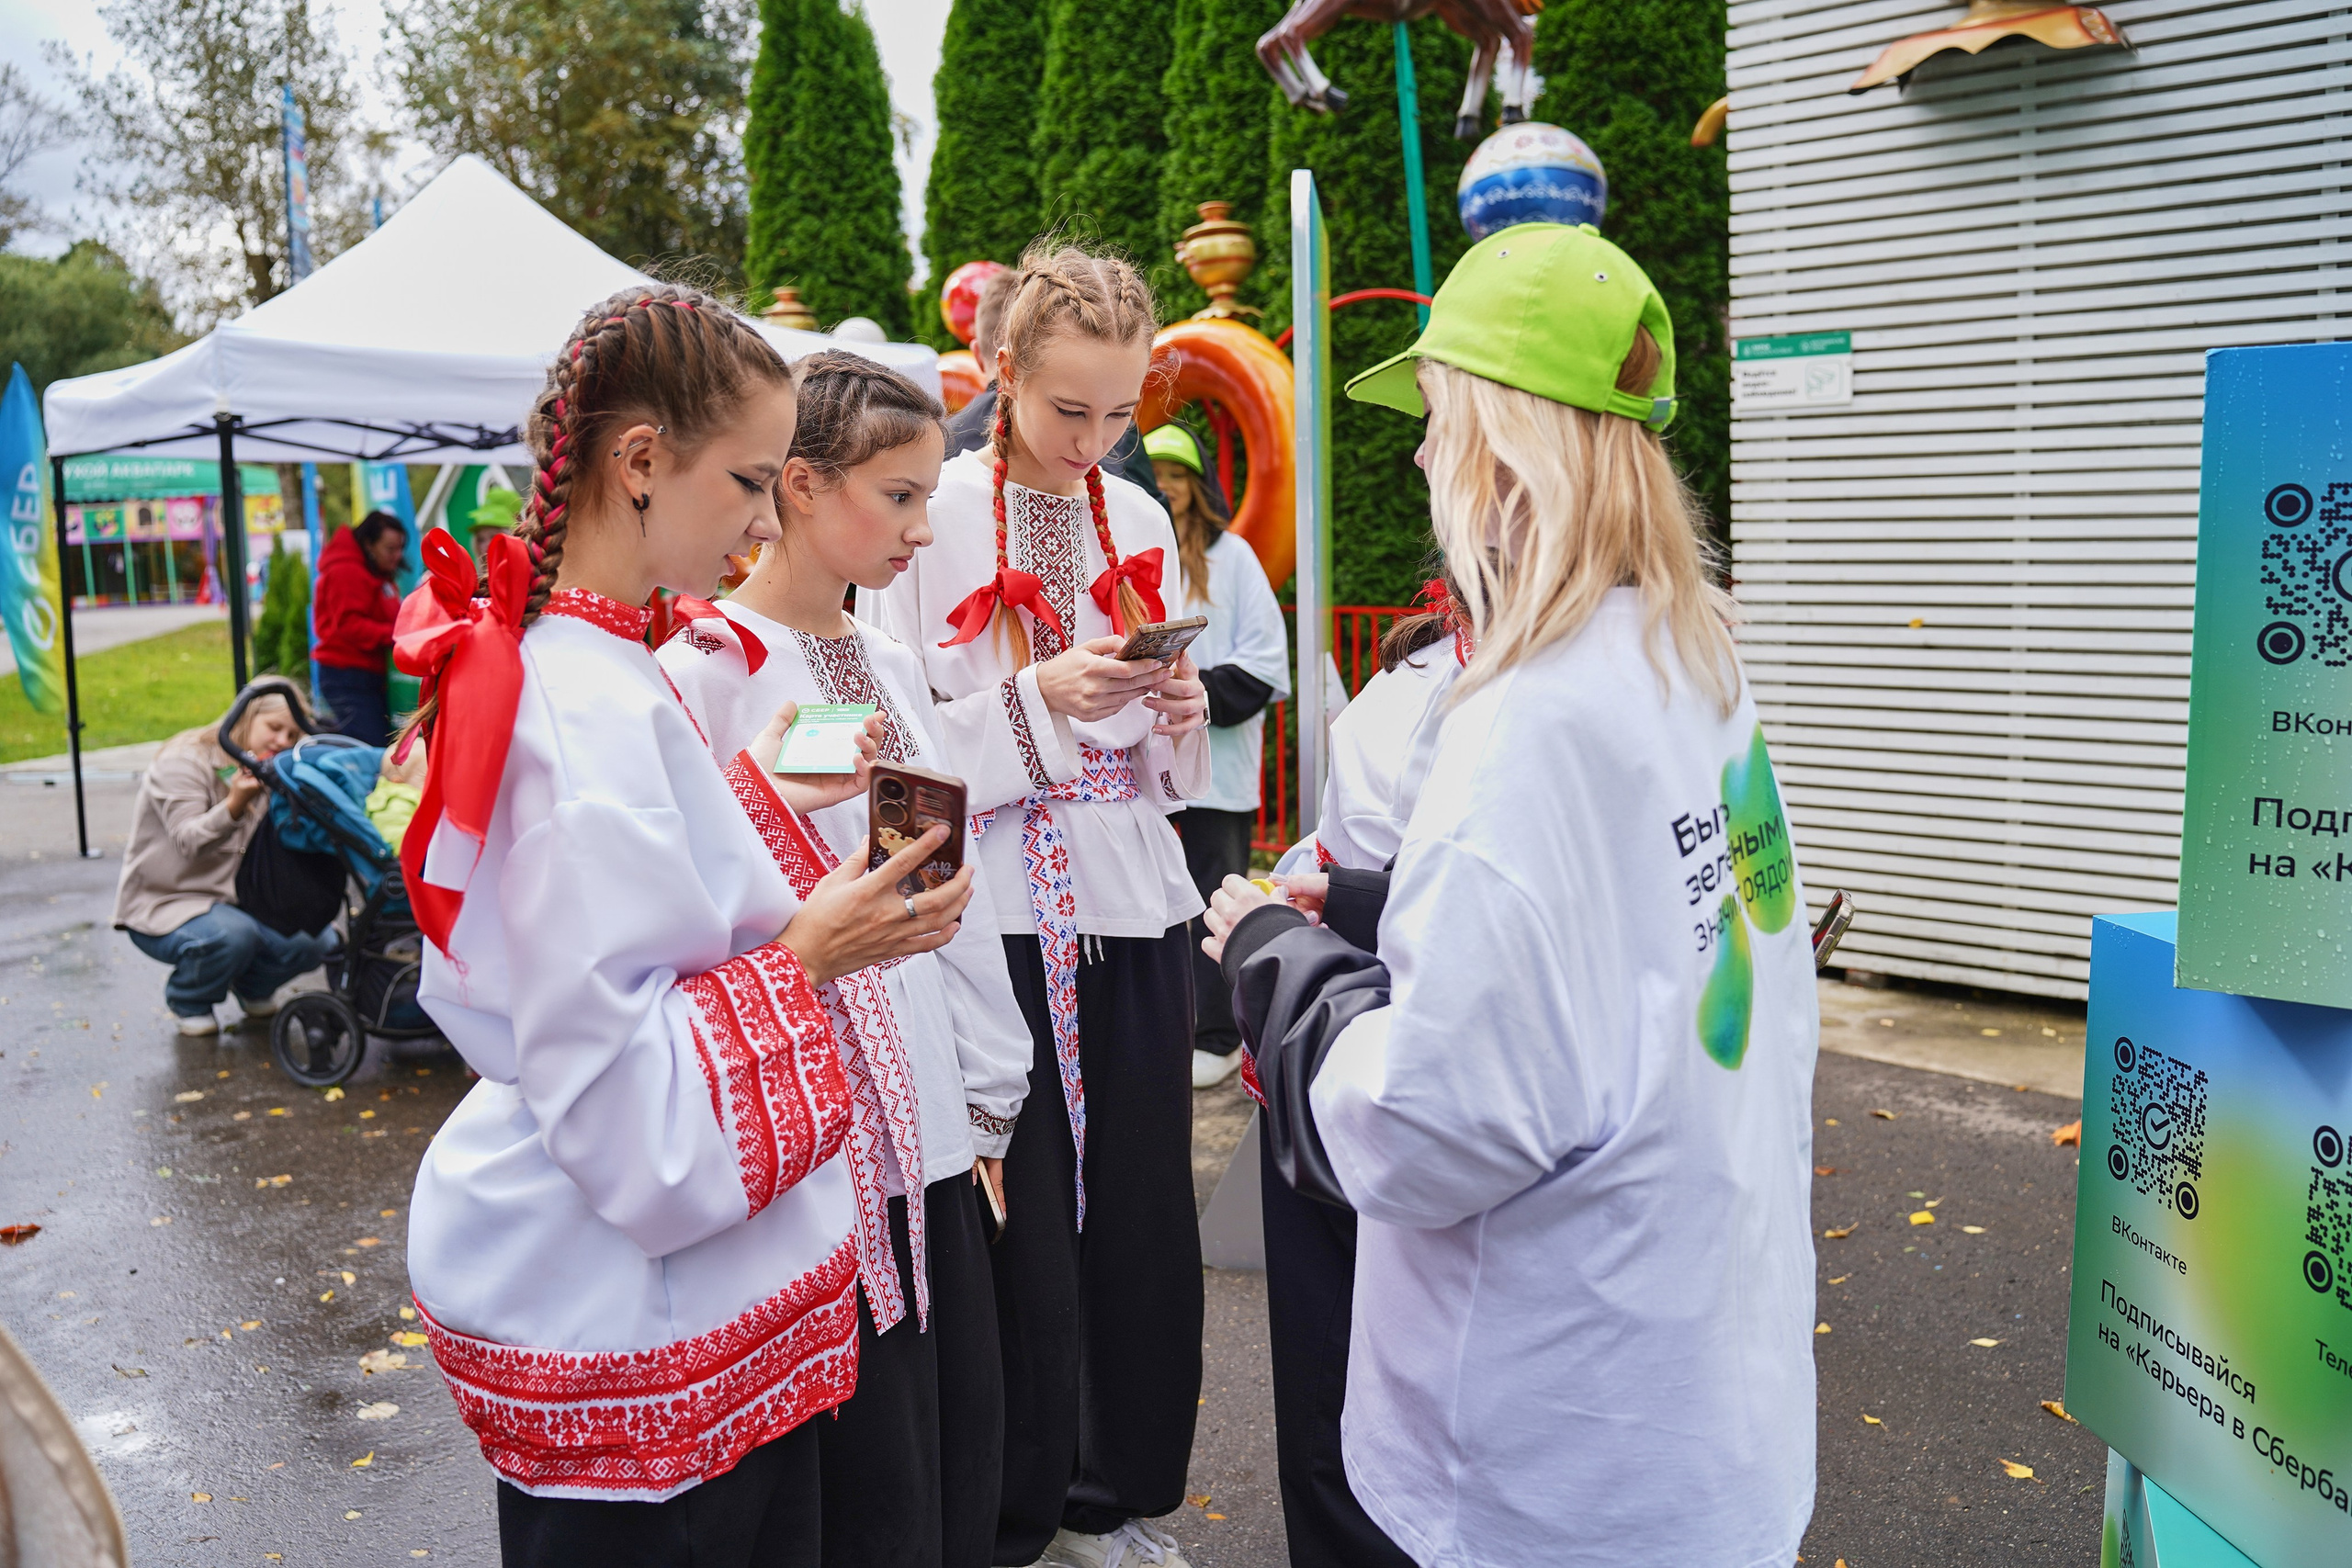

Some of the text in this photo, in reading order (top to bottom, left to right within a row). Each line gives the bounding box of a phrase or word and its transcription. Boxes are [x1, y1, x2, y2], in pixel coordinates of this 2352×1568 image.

[62, 460, 108, 480] УХОЙ
[9, 461, 41, 587] СБЕР
[2249, 852, 2296, 878] на
[2112, 1214, 2188, 1276] ВКонтакте
[2100, 1278, 2256, 1405] Подписывайся
[2315, 1337, 2352, 1380] Тел
[2098, 1321, 2352, 1517] на «Карьера в Сберба
